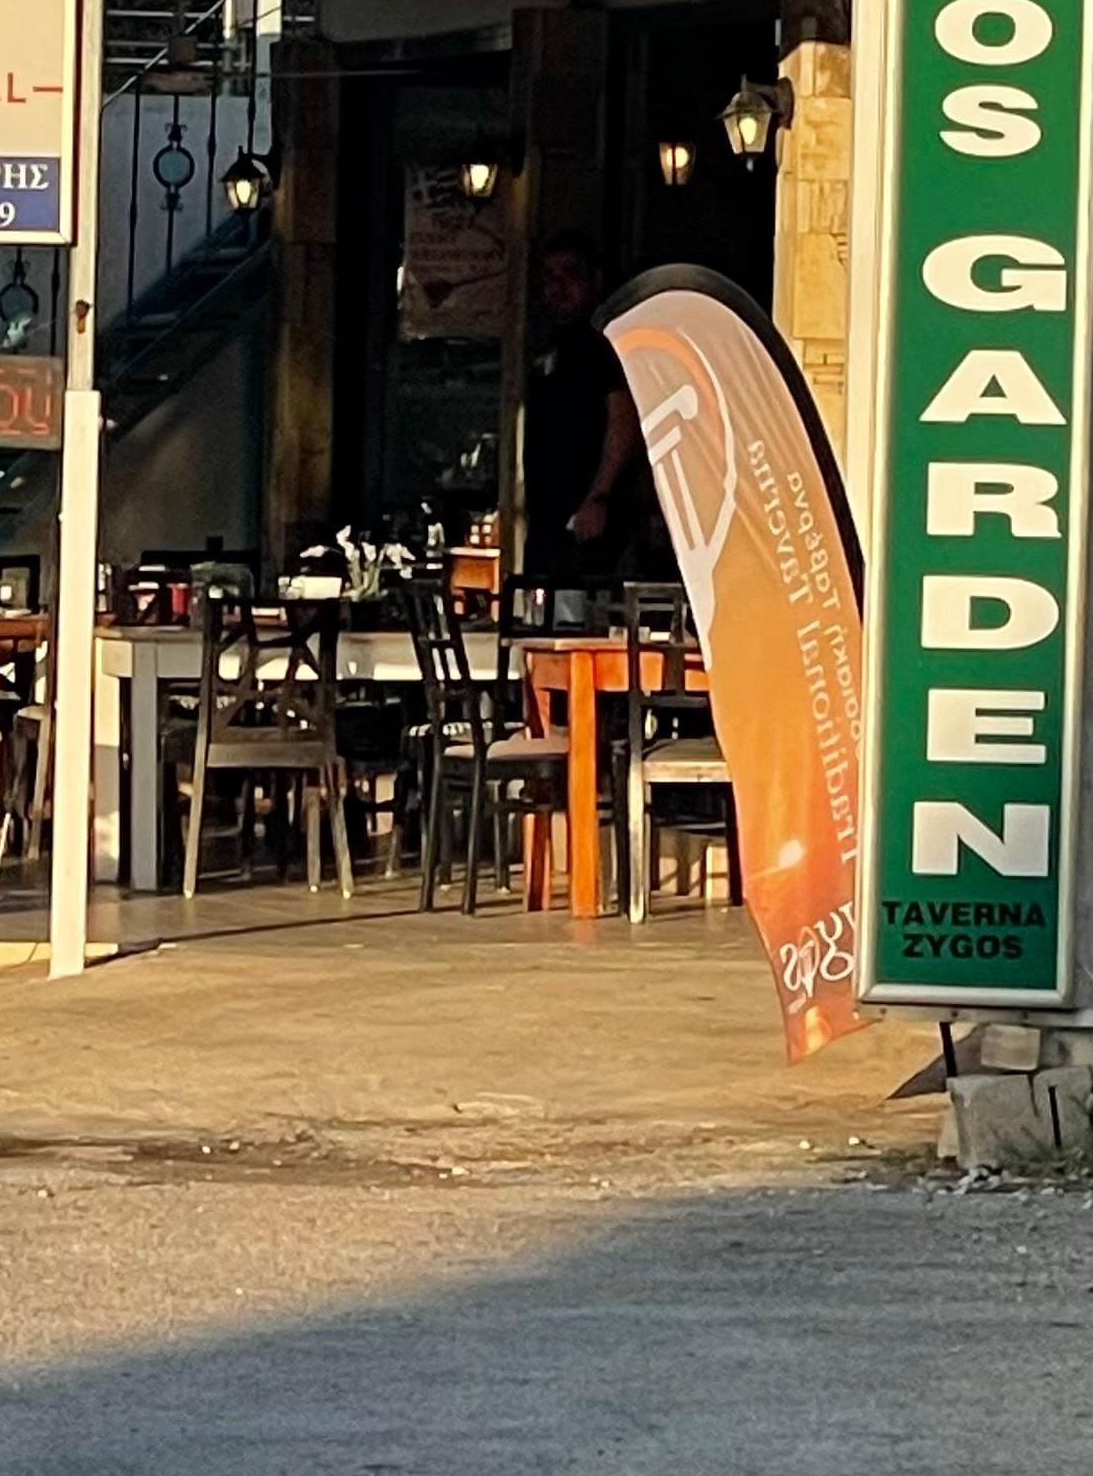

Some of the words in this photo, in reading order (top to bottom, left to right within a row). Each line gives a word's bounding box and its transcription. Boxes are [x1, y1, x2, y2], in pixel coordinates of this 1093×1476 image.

[912, 234, 1067, 877] GARDEN
[882, 900, 1047, 928] TAVERNA
[902, 934, 1023, 960] ZYGOS
